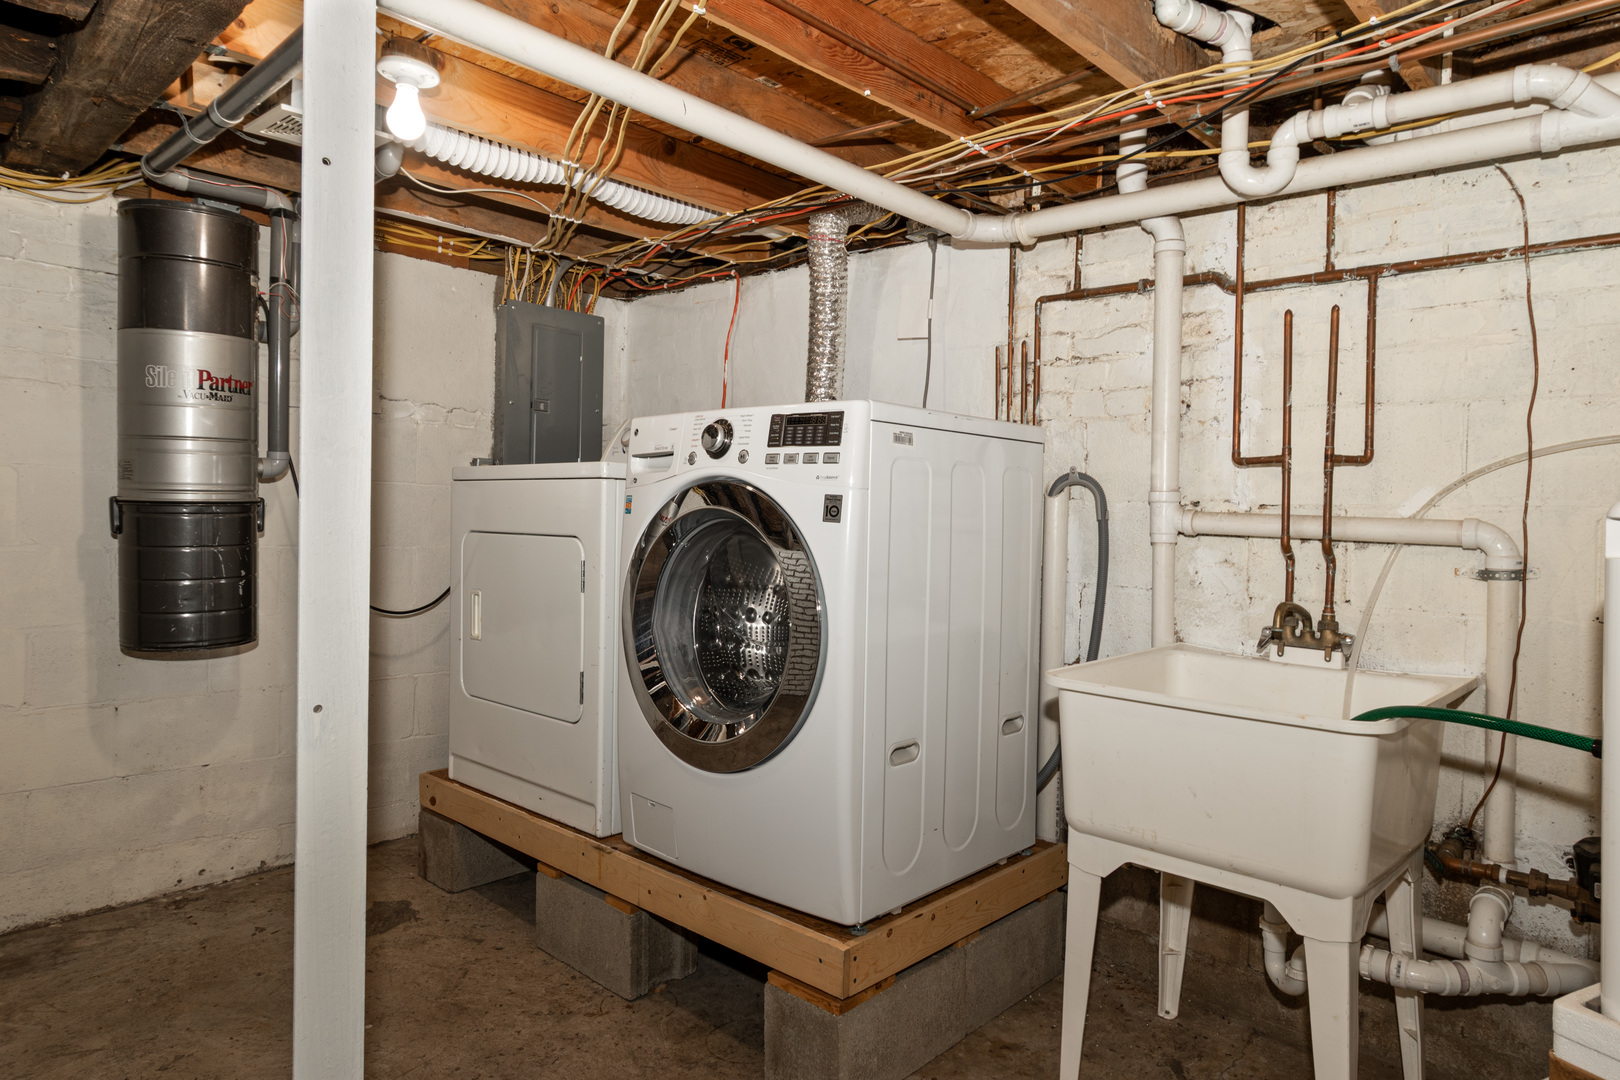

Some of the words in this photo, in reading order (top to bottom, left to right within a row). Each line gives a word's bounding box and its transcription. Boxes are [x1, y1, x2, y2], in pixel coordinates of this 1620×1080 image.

[145, 364, 197, 390] Sile
[197, 369, 253, 395] Partner
[825, 504, 840, 518] 10
